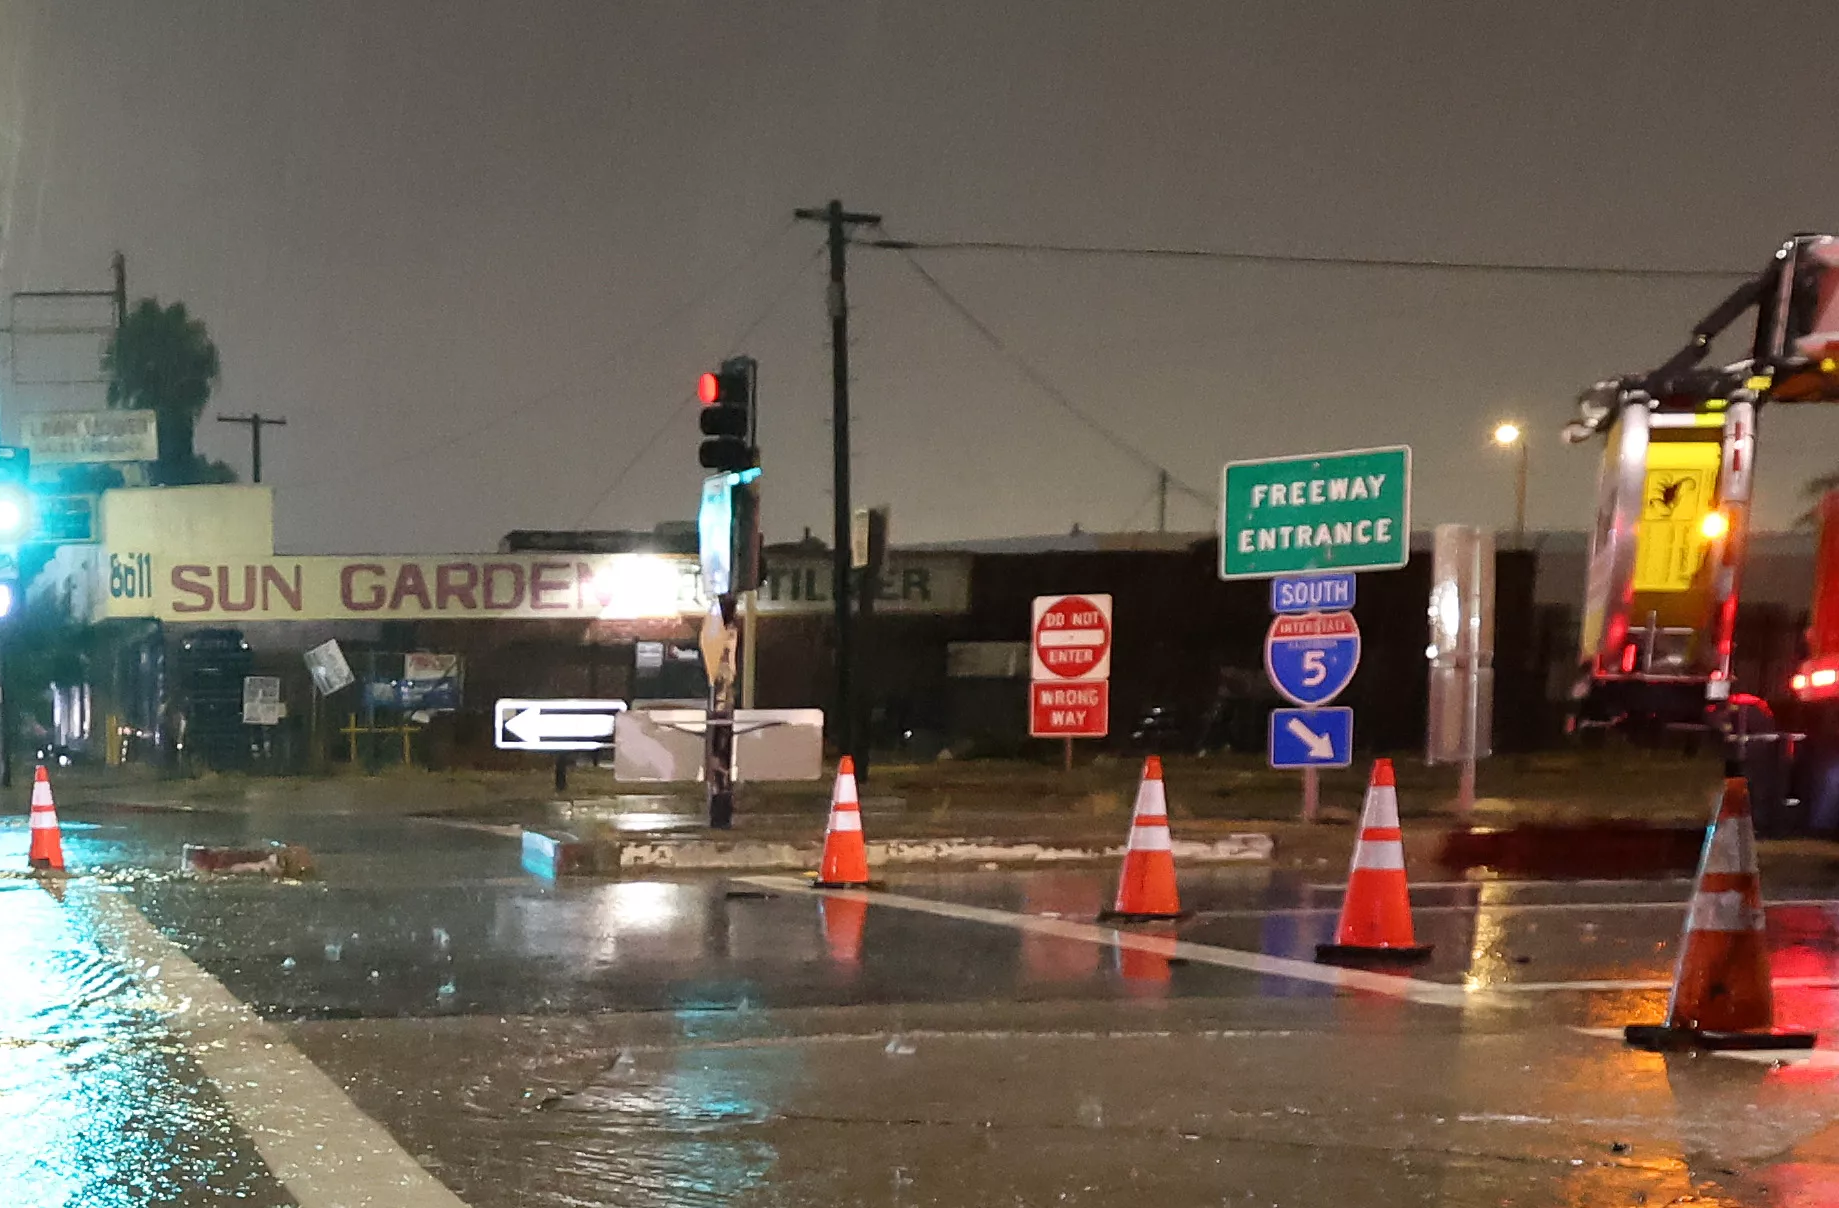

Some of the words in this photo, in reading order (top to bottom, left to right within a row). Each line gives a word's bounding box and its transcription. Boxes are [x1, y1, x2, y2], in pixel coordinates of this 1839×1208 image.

[1251, 473, 1387, 509] FREEWAY
[1237, 517, 1393, 553] ENTRANCE
[171, 562, 304, 613] SUN
[1281, 580, 1349, 606] SOUTH
[1046, 612, 1065, 627] DO
[1072, 610, 1099, 626] NOT
[1048, 648, 1093, 663] ENTER
[1302, 650, 1328, 687] 5
[1041, 689, 1099, 706] WRONG
[1050, 710, 1087, 726] WAY
